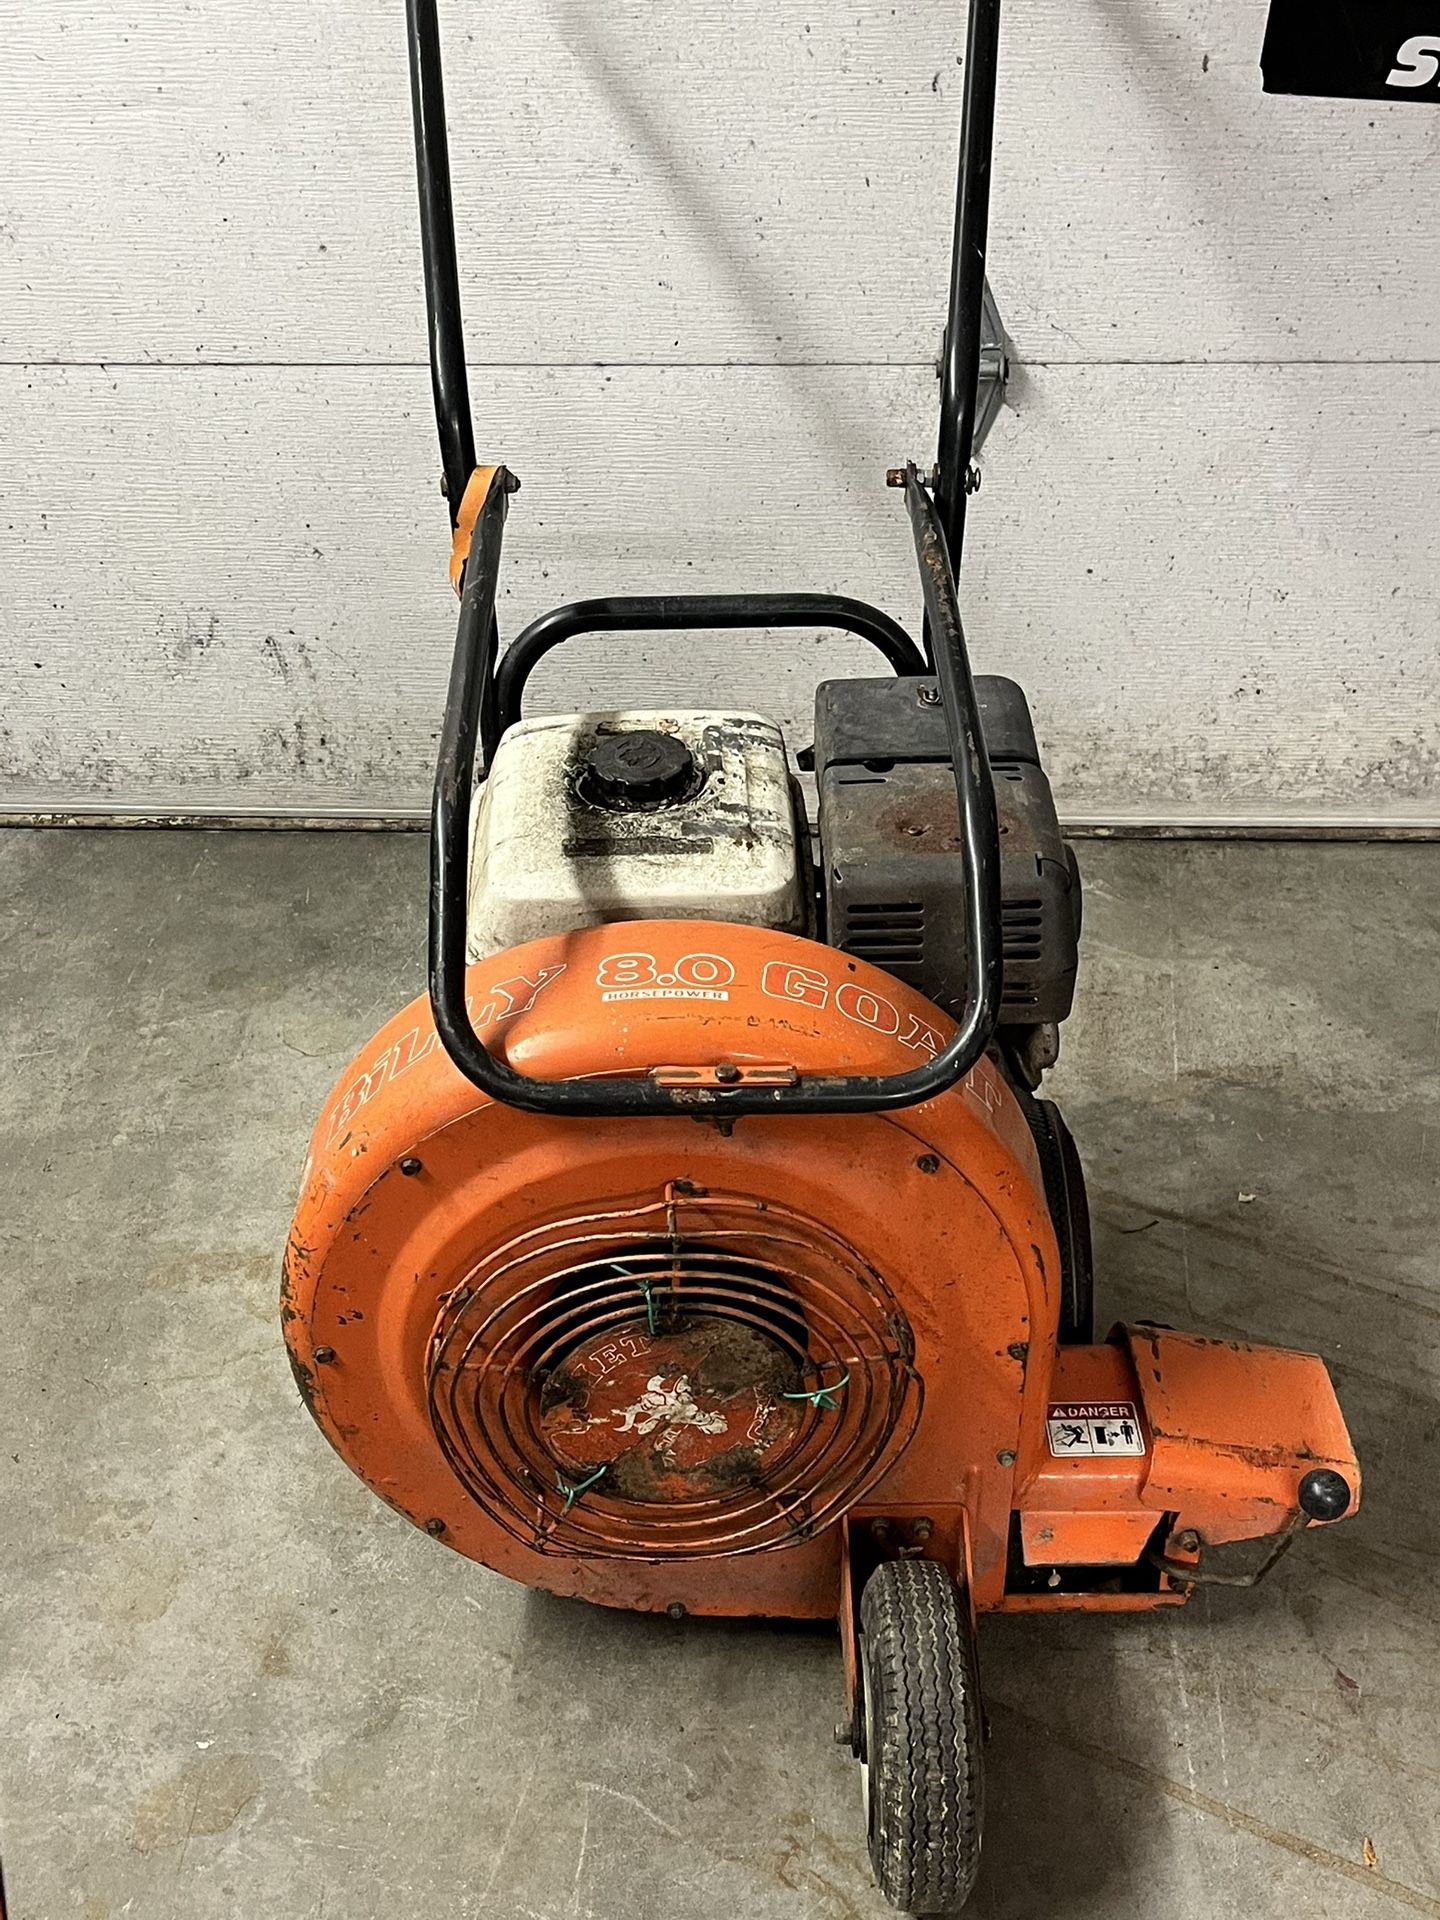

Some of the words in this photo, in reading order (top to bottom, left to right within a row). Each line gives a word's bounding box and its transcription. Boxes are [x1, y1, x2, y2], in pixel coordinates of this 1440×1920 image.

[1385, 35, 1440, 88] S
[595, 952, 736, 988] 8.0
[607, 989, 723, 1000] HORSEPOWER
[1067, 1406, 1130, 1418] DANGER
